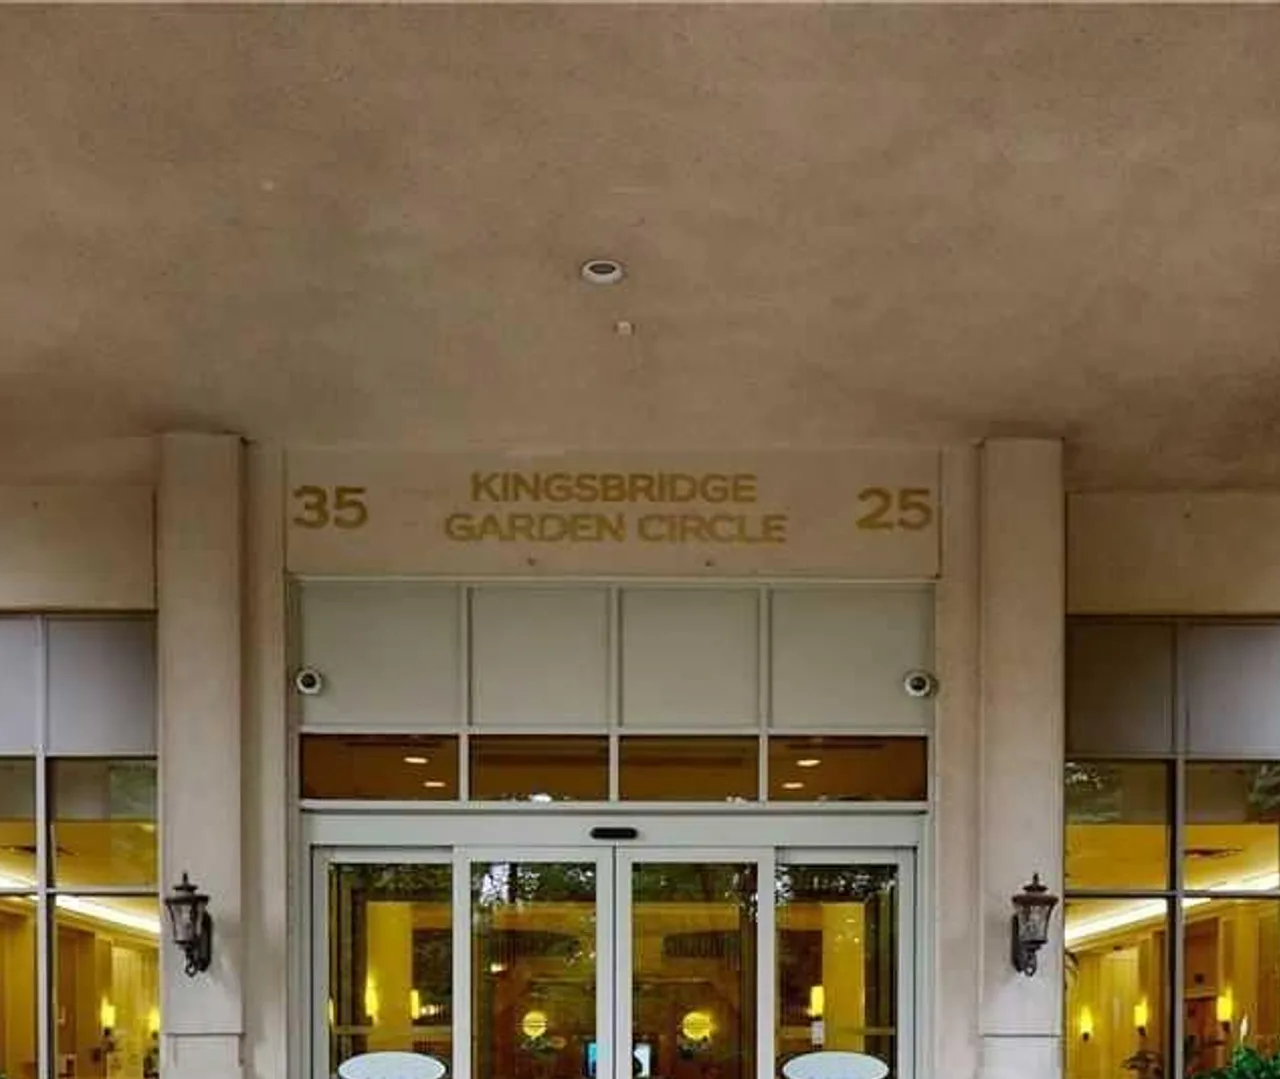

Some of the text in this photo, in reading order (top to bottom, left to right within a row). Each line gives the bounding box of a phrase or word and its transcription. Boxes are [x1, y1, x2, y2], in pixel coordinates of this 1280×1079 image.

[472, 472, 758, 502] KINGSBRIDGE
[293, 486, 369, 529] 35
[856, 487, 933, 530] 25
[444, 513, 789, 544] GARDEN CIRCLE
